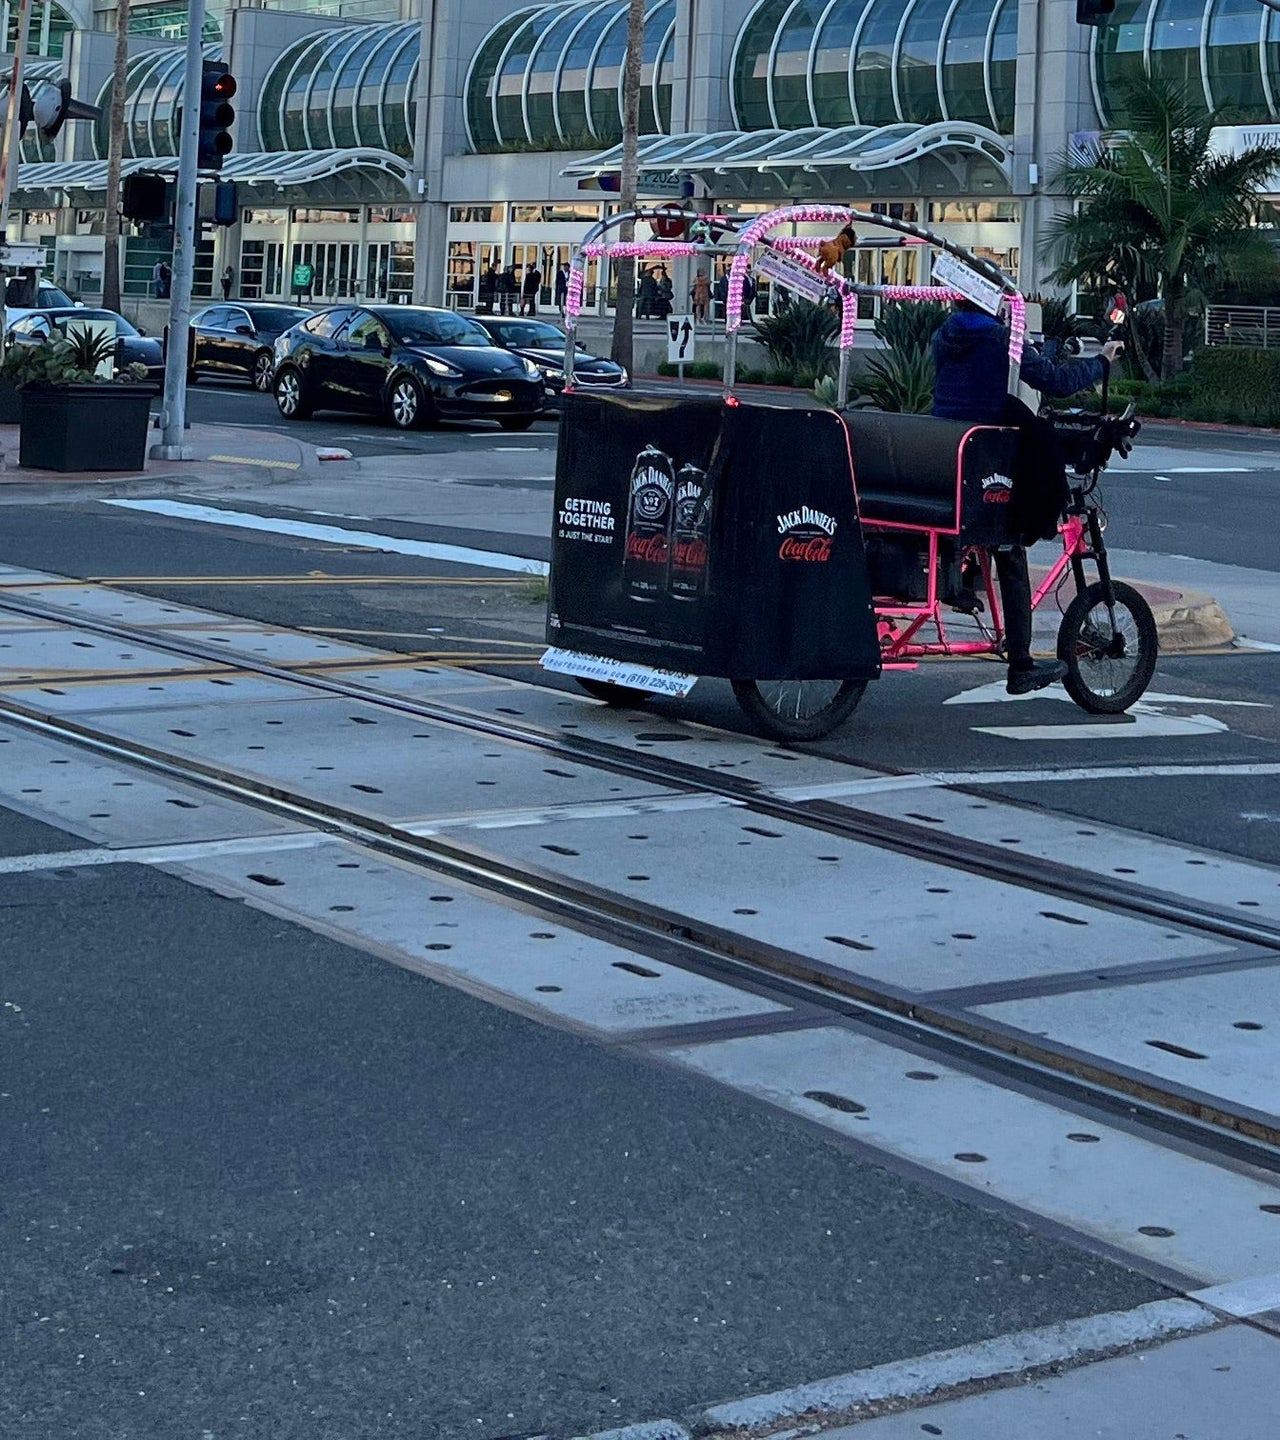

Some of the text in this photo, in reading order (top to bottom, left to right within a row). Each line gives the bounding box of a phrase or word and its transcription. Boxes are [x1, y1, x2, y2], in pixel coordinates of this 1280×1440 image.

[564, 497, 612, 516] GETTING
[558, 511, 615, 531] TOGETHER
[776, 509, 802, 534] JACK
[565, 530, 581, 540] JUST
[581, 532, 594, 542] THE
[594, 534, 614, 544] START
